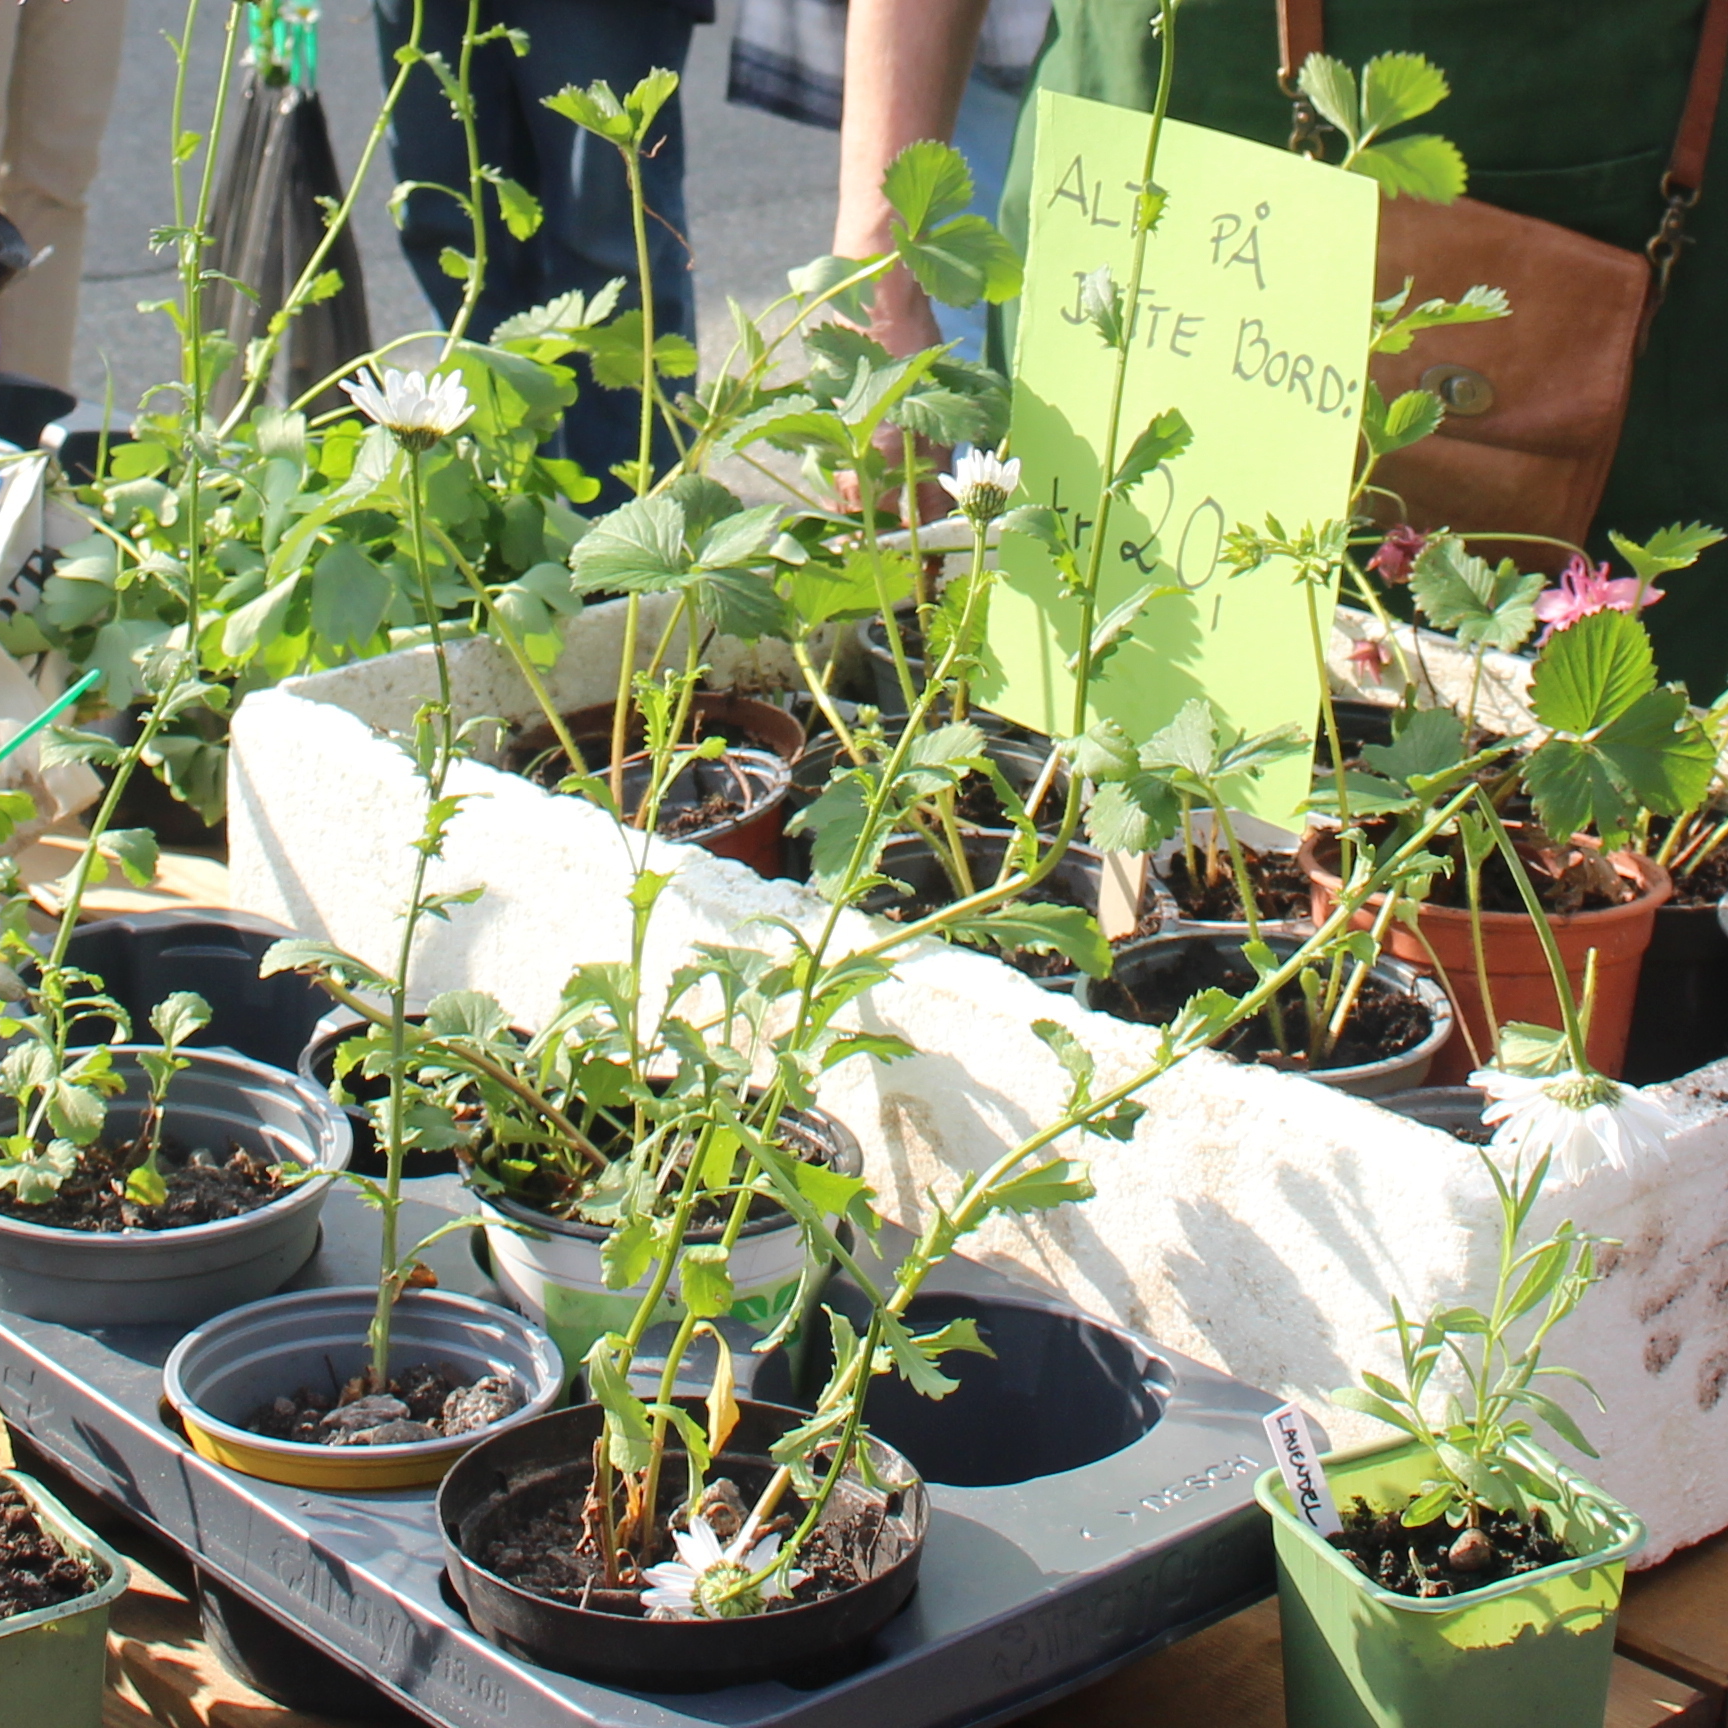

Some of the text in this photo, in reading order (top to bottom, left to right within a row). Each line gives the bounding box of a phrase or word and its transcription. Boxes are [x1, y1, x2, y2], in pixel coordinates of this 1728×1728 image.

[1210, 200, 1271, 291] PÅ
[1060, 270, 1358, 419] DTTE BORD:
